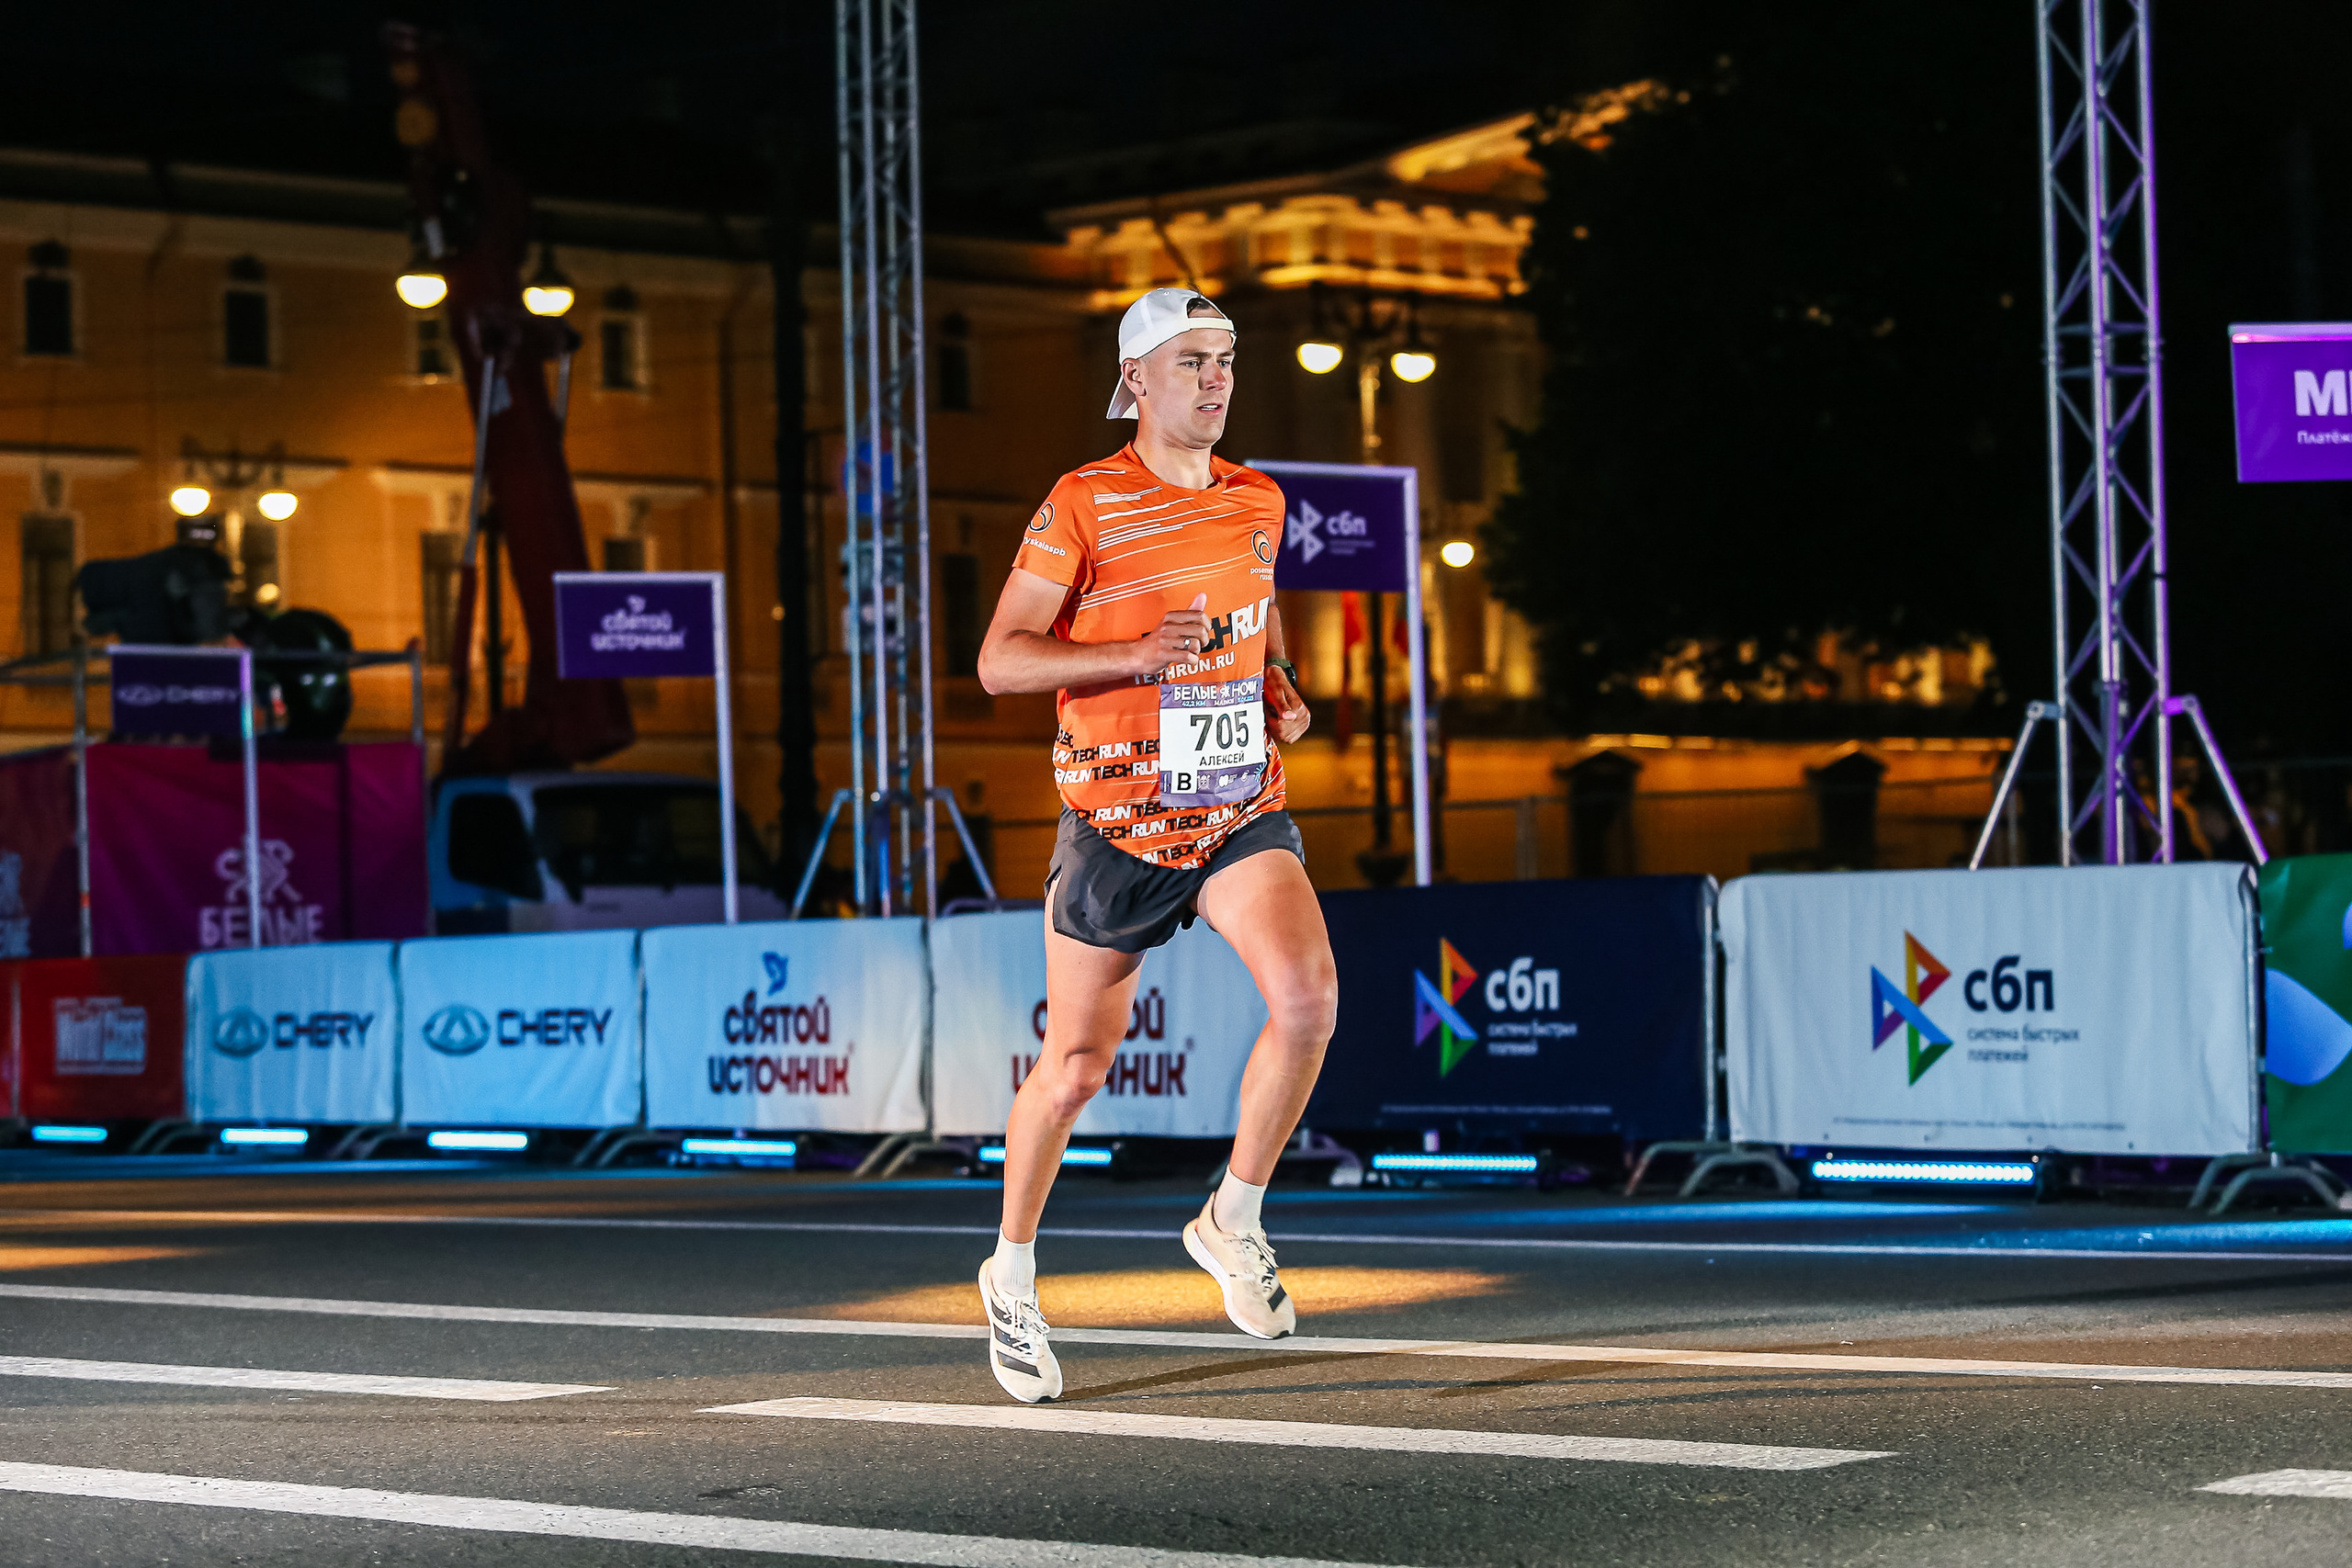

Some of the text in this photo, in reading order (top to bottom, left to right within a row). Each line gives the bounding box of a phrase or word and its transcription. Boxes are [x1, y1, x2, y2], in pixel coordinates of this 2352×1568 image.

[2293, 369, 2352, 417] М
[1173, 683, 1217, 701] БЕЛЫЕ
[1190, 709, 1250, 751] 705
[1199, 750, 1245, 766] АЛЕКСЕЙ
[1485, 956, 1560, 1012] сбп
[1963, 954, 2055, 1013] сбп
[275, 1012, 375, 1050] CHERY
[498, 1007, 614, 1046] CHERY
